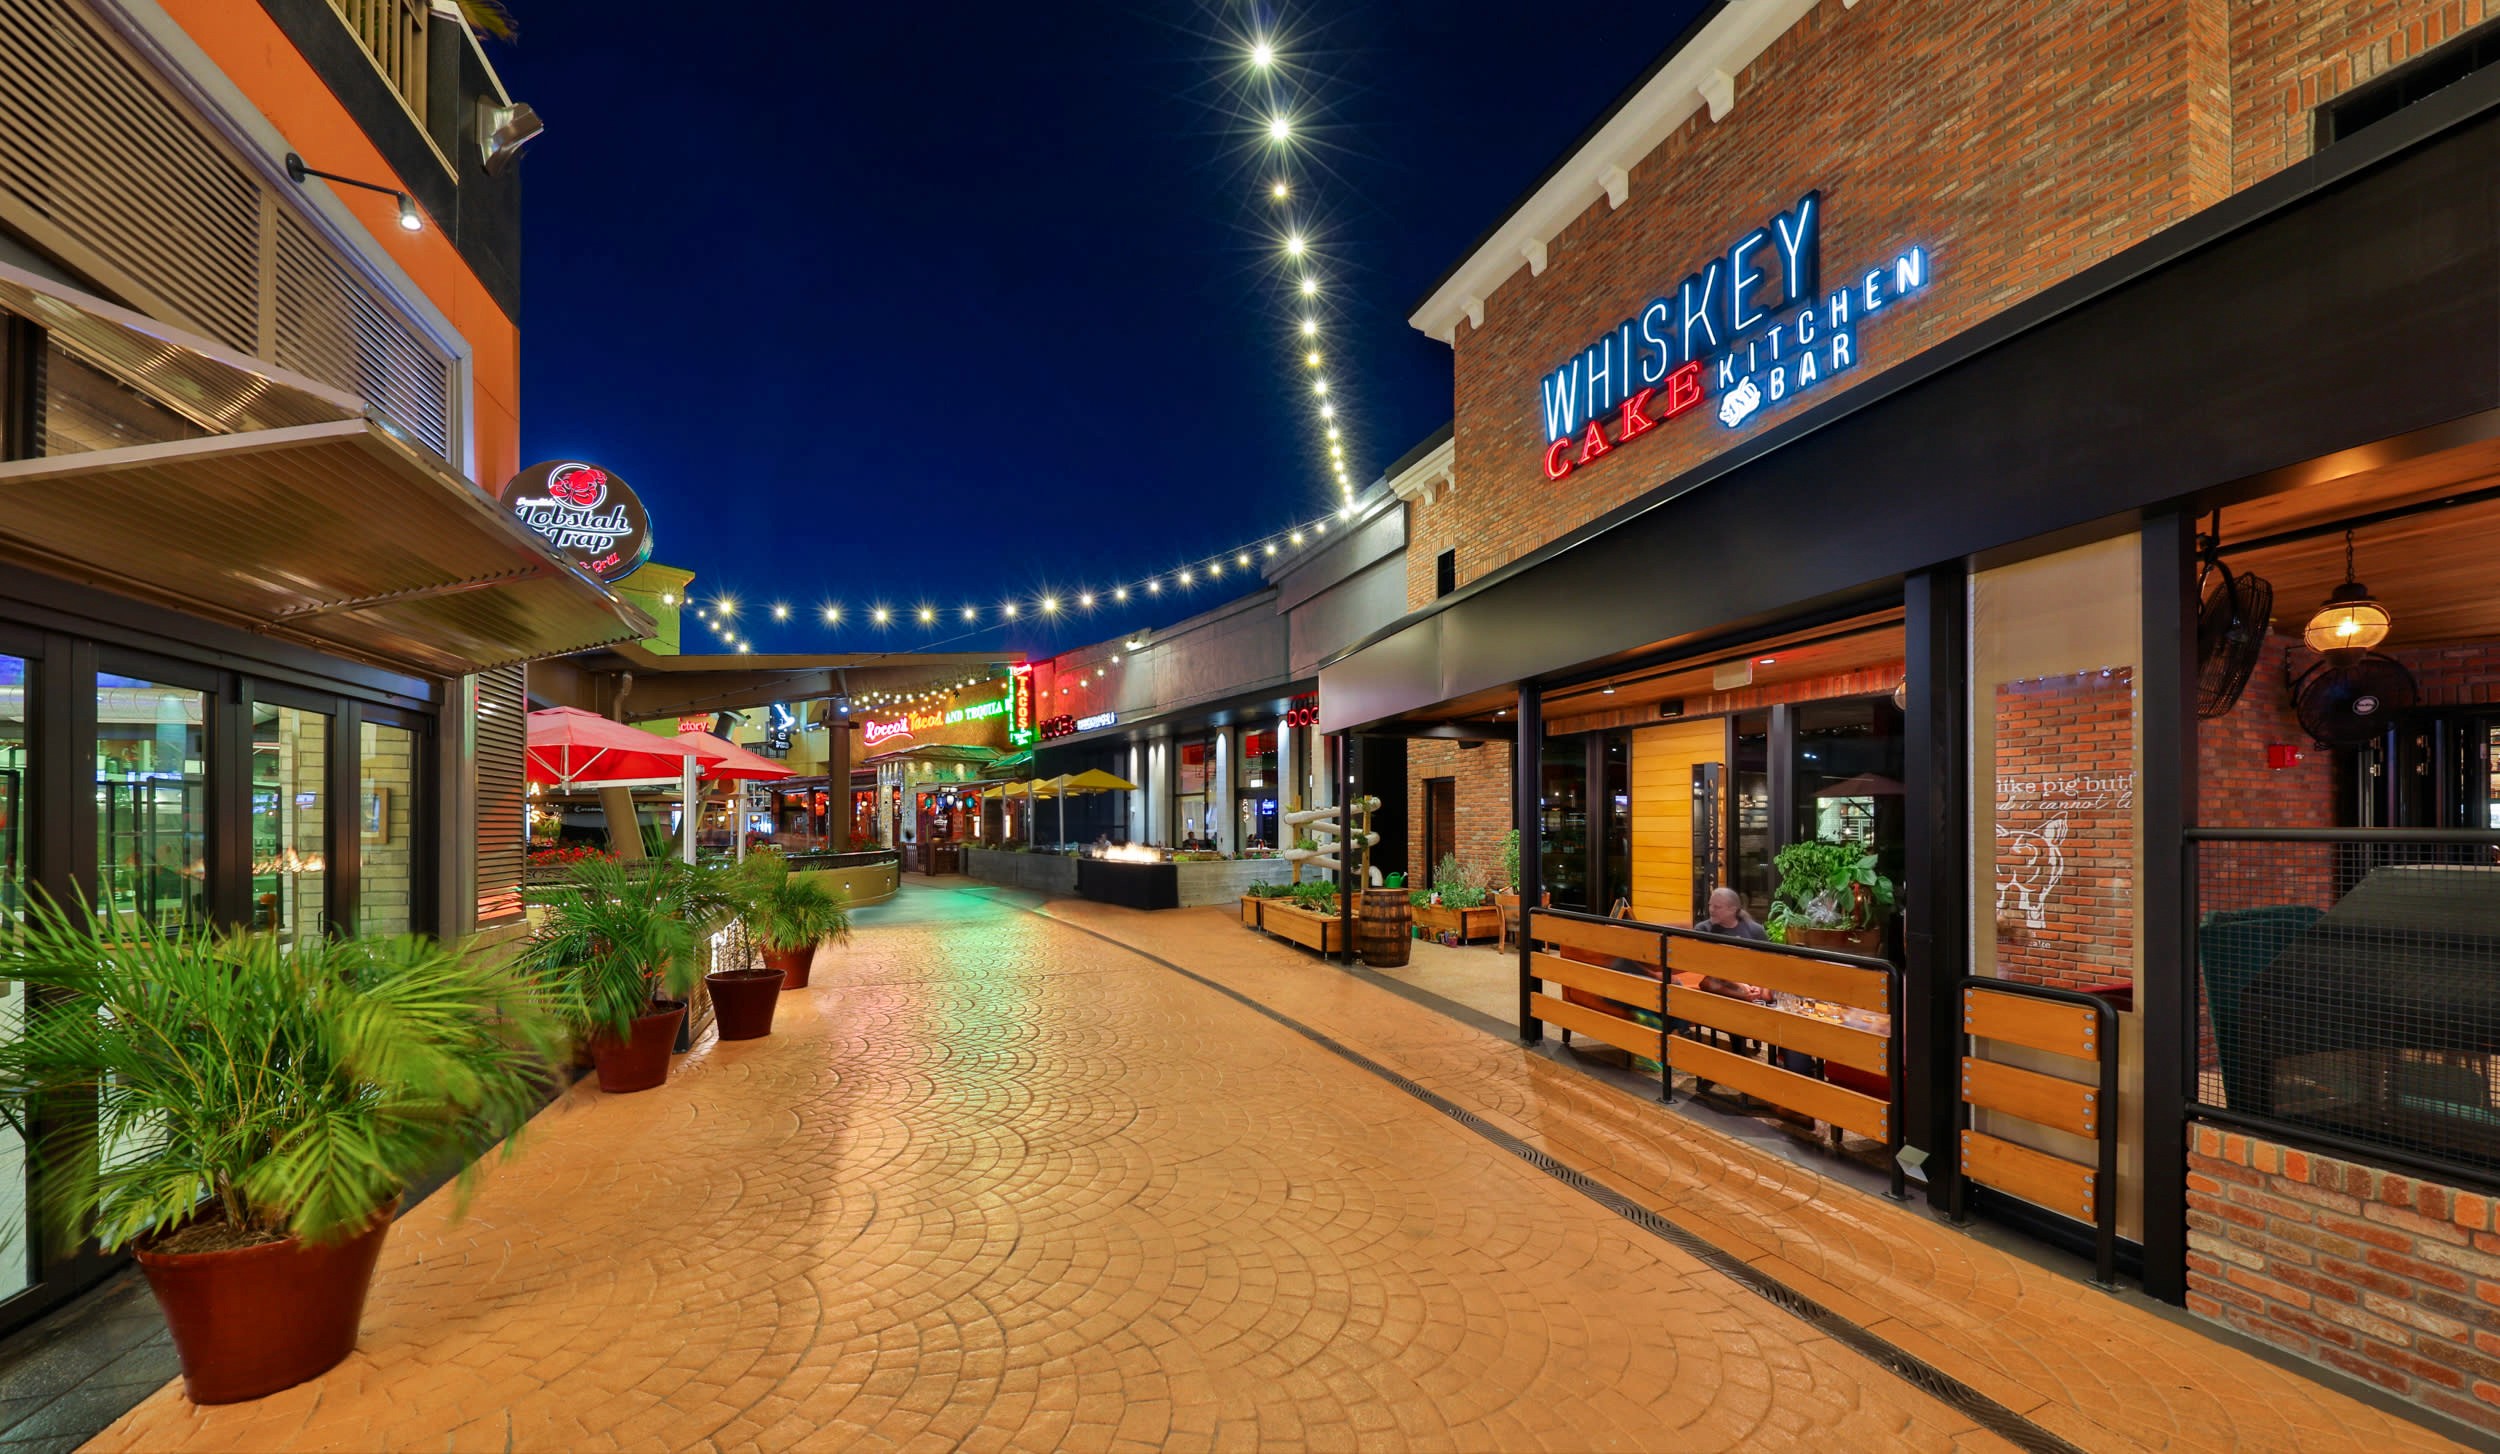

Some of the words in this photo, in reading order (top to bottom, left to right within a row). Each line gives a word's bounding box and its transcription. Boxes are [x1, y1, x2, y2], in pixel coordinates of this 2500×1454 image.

[1542, 194, 1816, 443] WHISKEY
[1717, 245, 1929, 389] KITCHEN
[1769, 333, 1852, 402] BAR
[1543, 360, 1705, 481] CAKE
[515, 504, 631, 531] Lobstah
[545, 527, 614, 554] Trap
[866, 717, 909, 739] Rocco's
[908, 710, 944, 731] Tacos
[945, 709, 964, 725] AND
[965, 701, 1003, 721] TEQUILA
[1017, 676, 1029, 728] TACOS
[679, 720, 708, 733] ctory
[2039, 793, 2110, 810] cannot
[2042, 777, 2078, 797] pig
